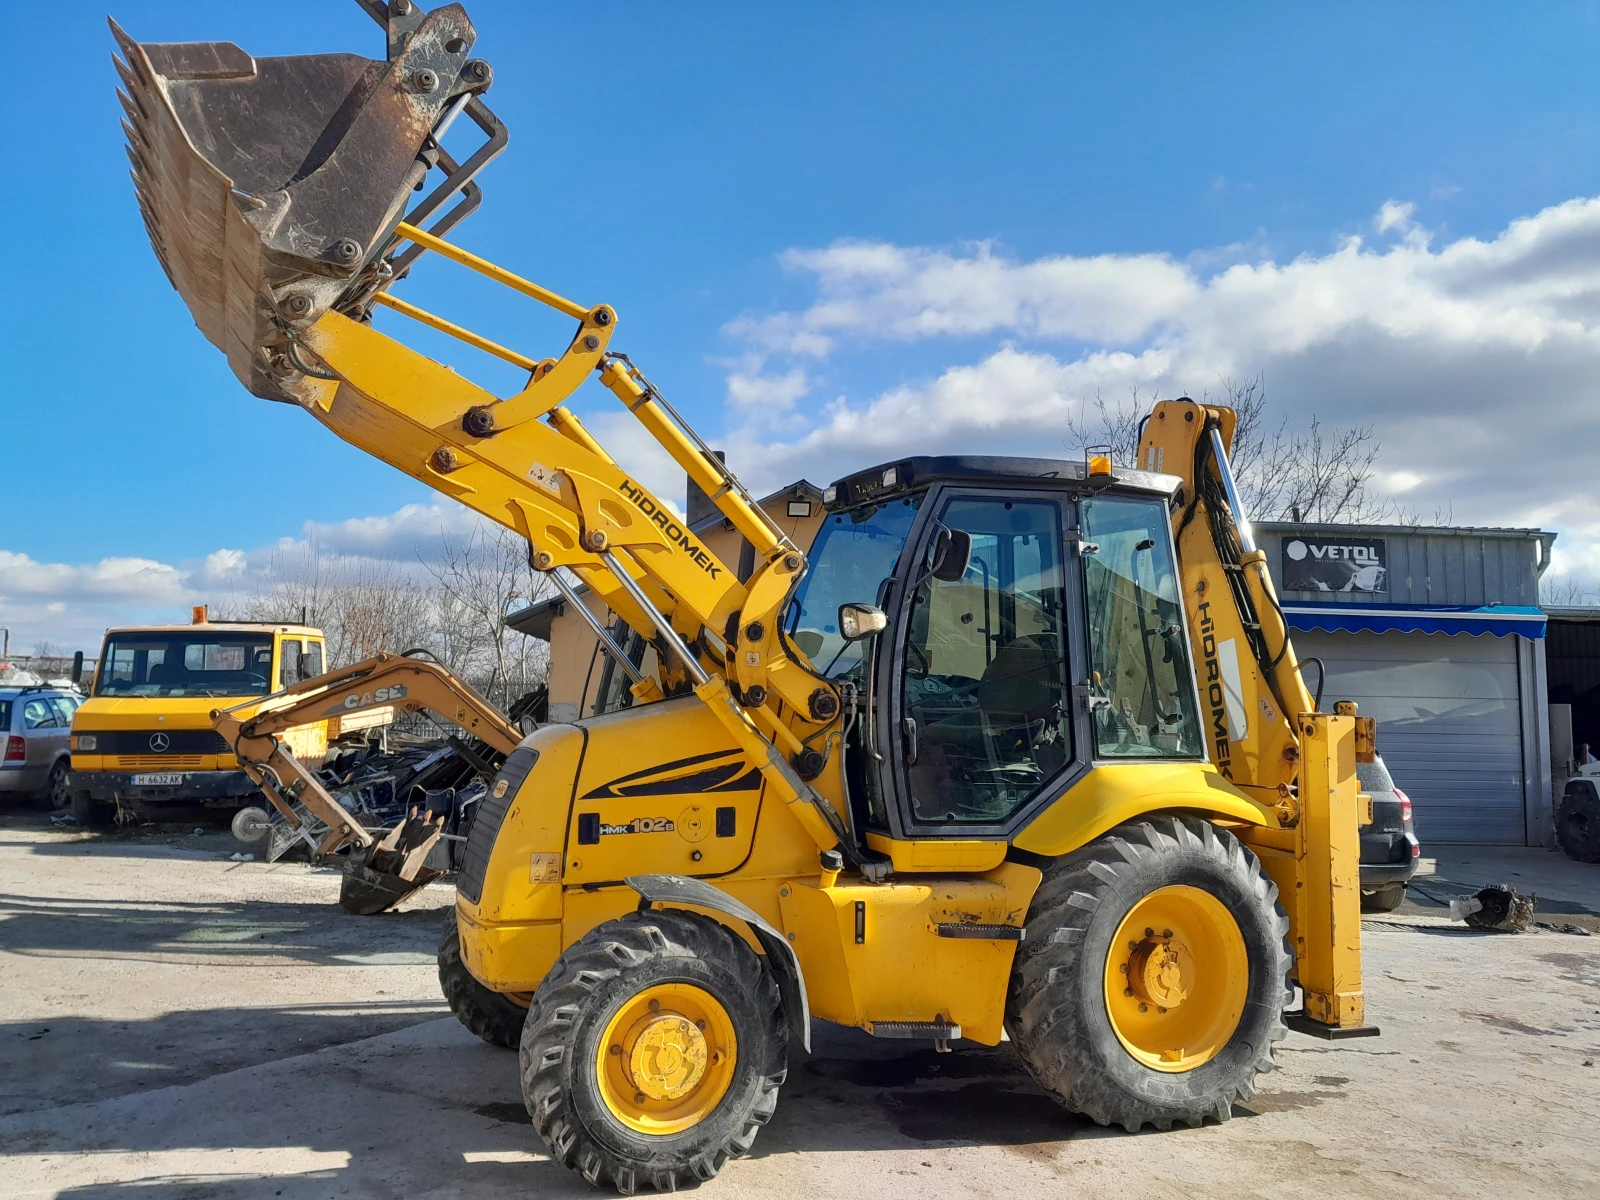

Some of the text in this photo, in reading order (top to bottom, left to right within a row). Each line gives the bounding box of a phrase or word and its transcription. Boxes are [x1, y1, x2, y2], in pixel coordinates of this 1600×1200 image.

[344, 684, 403, 709] CASE
[138, 775, 180, 785] H 6632 AK
[599, 817, 674, 835] HMK 102B
